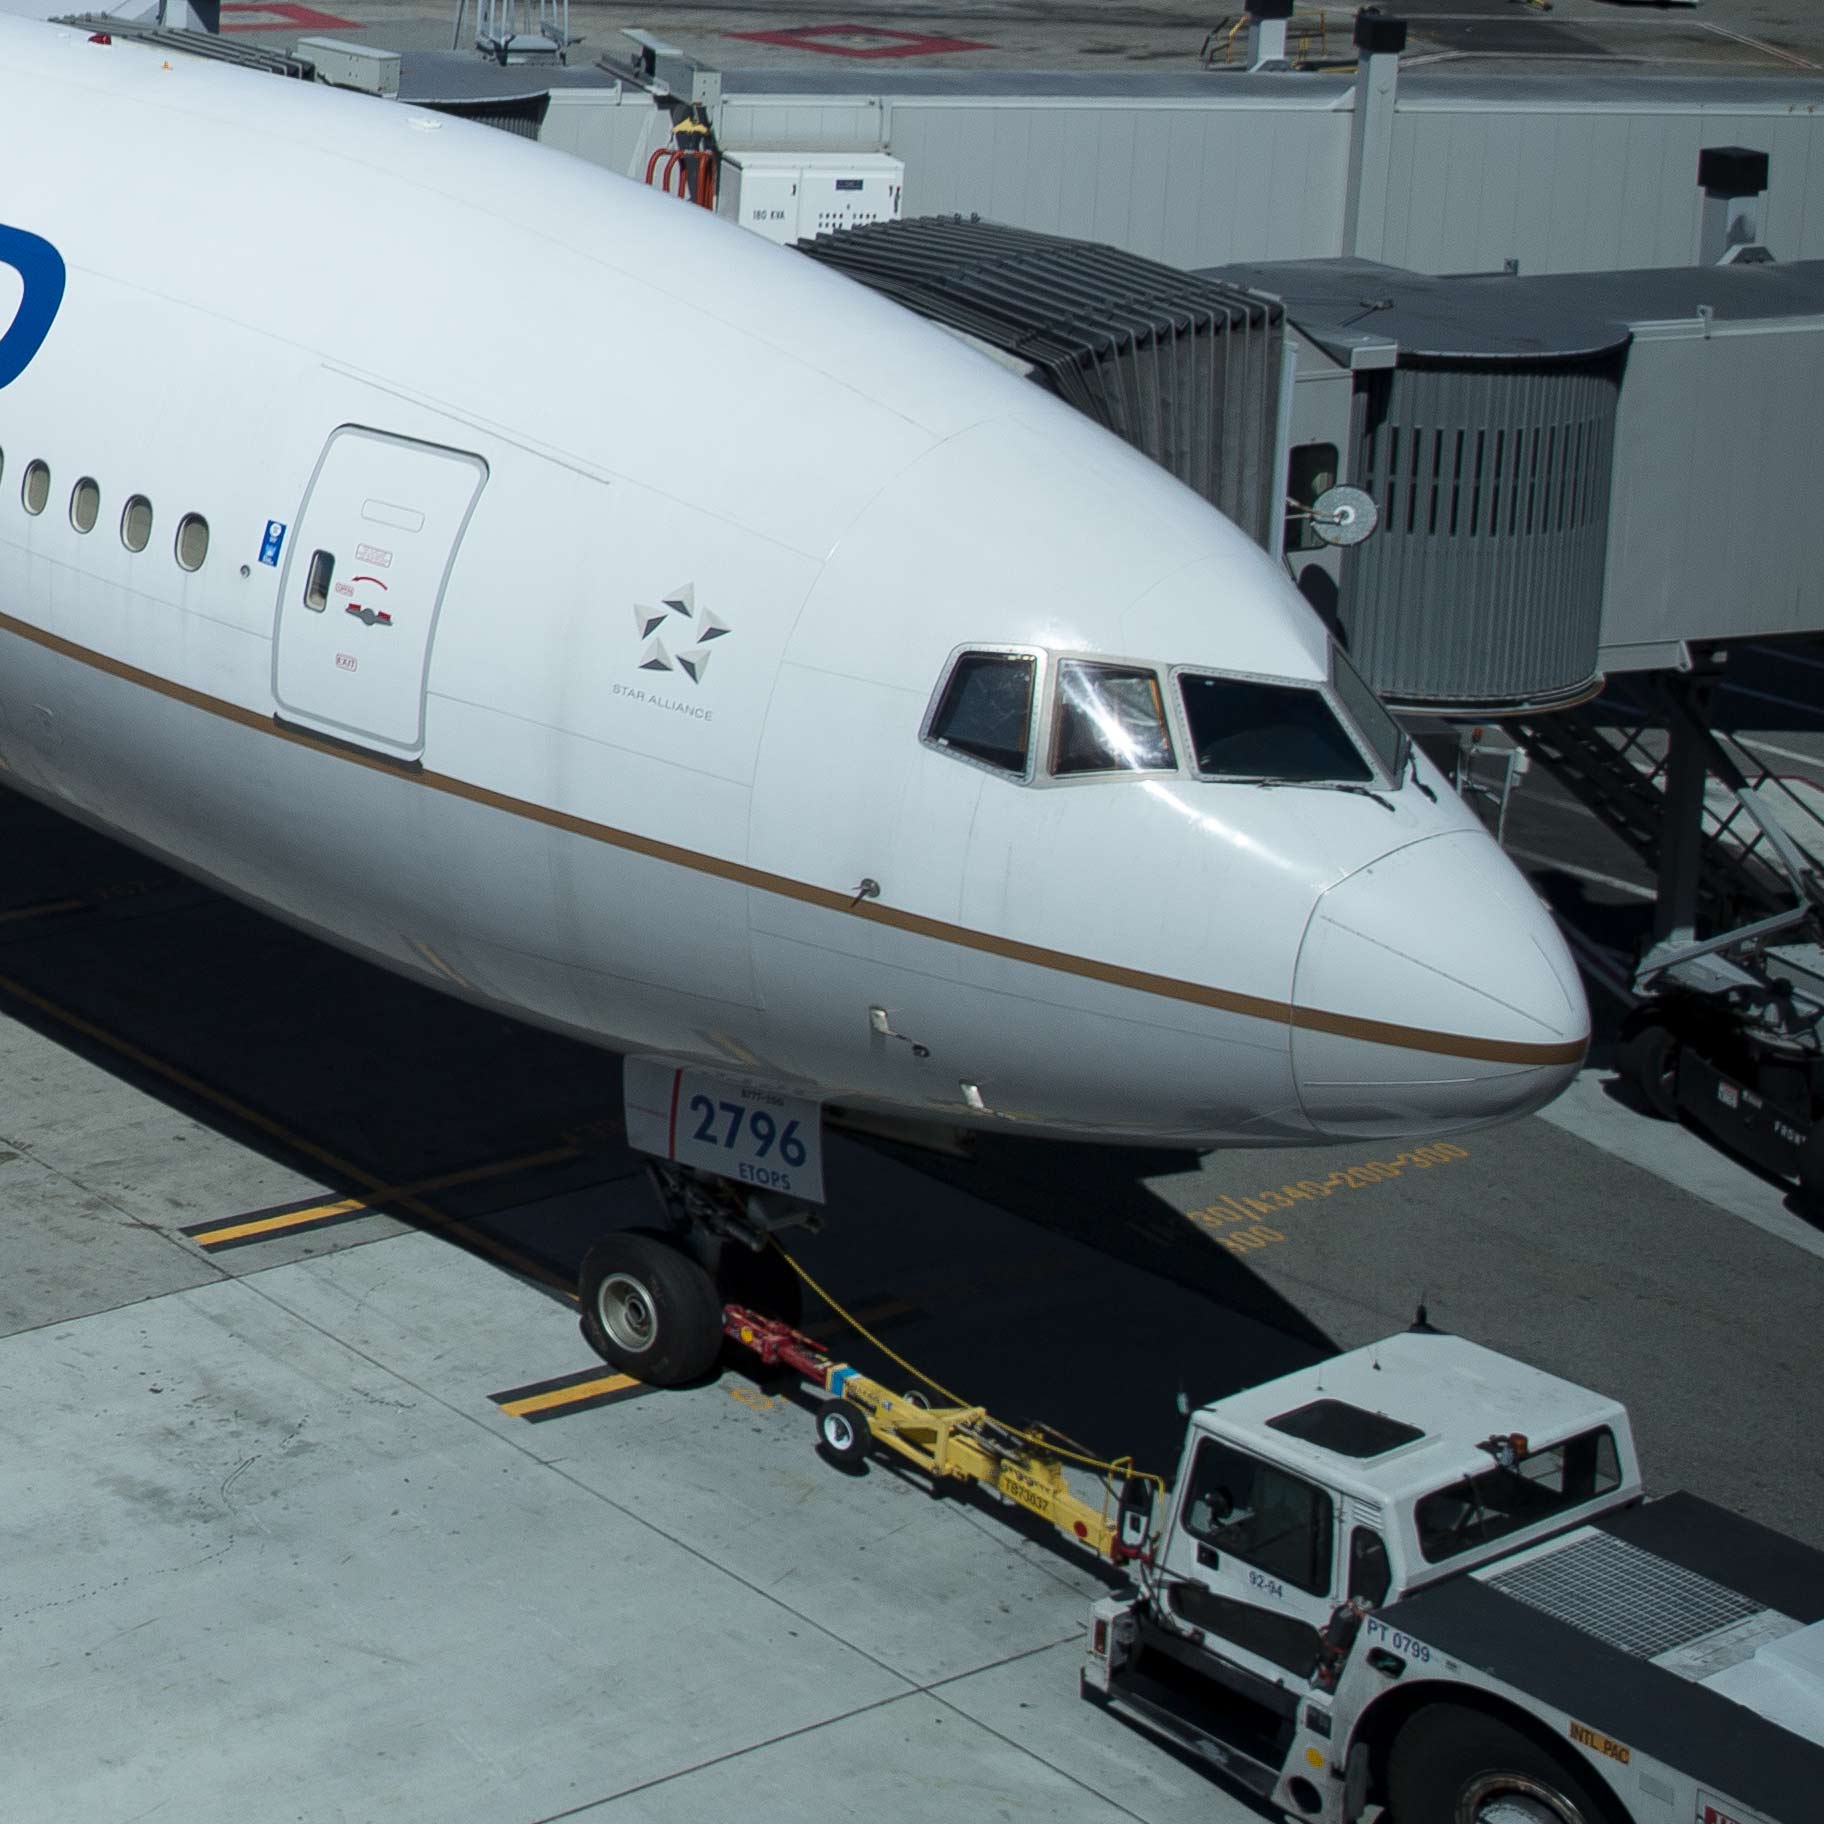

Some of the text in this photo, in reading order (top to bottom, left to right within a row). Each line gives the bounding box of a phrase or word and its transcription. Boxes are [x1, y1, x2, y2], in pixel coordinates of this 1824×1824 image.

[612, 683, 713, 722] STAR ALLIANCE
[689, 1094, 807, 1168] 2796
[738, 1162, 792, 1191] ETOPS
[1367, 1618, 1431, 1663] PT 0799
